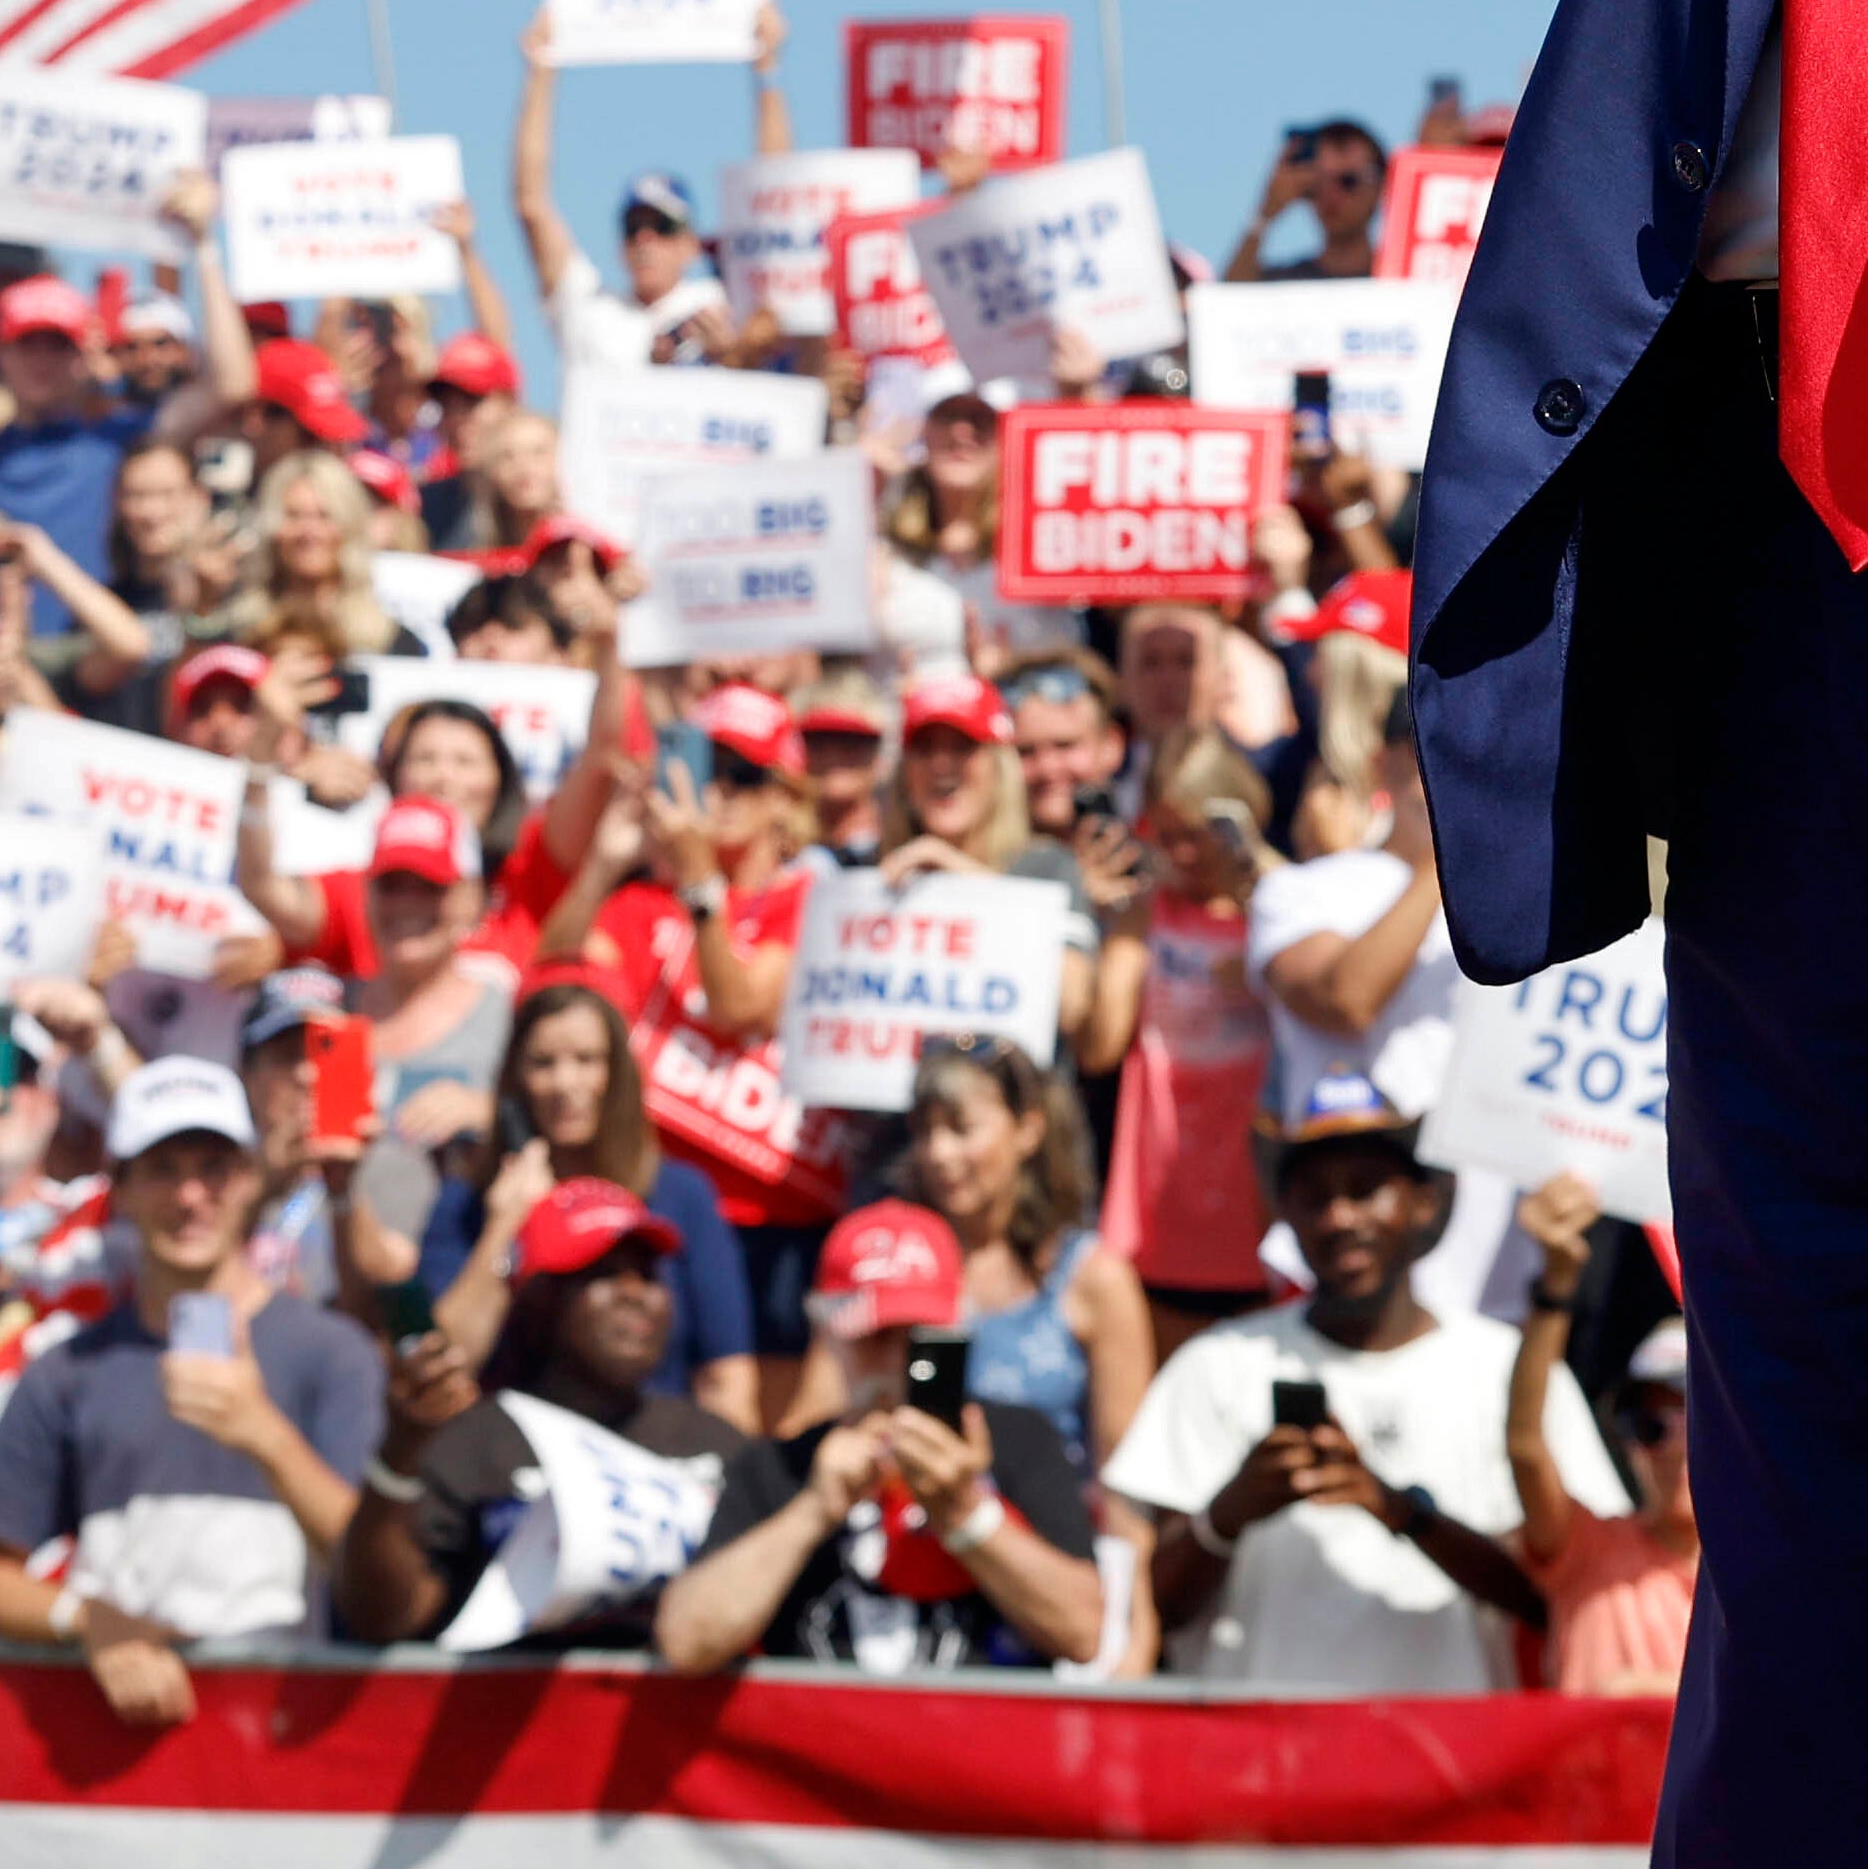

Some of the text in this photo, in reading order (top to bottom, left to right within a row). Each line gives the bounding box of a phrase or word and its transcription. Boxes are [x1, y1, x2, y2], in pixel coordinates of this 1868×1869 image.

[867, 37, 1041, 101] FIRE
[11, 150, 147, 194] 2024
[937, 202, 1119, 283] TRUMP
[979, 257, 1102, 324] 2024
[1033, 429, 1251, 507] FIRE
[1032, 510, 1247, 573] BIDEN
[82, 767, 220, 834] VOTE
[105, 875, 229, 930] UMP
[1514, 967, 1667, 1044] TRU
[805, 1016, 923, 1063] TRU
[1525, 1034, 1667, 1124] 202
